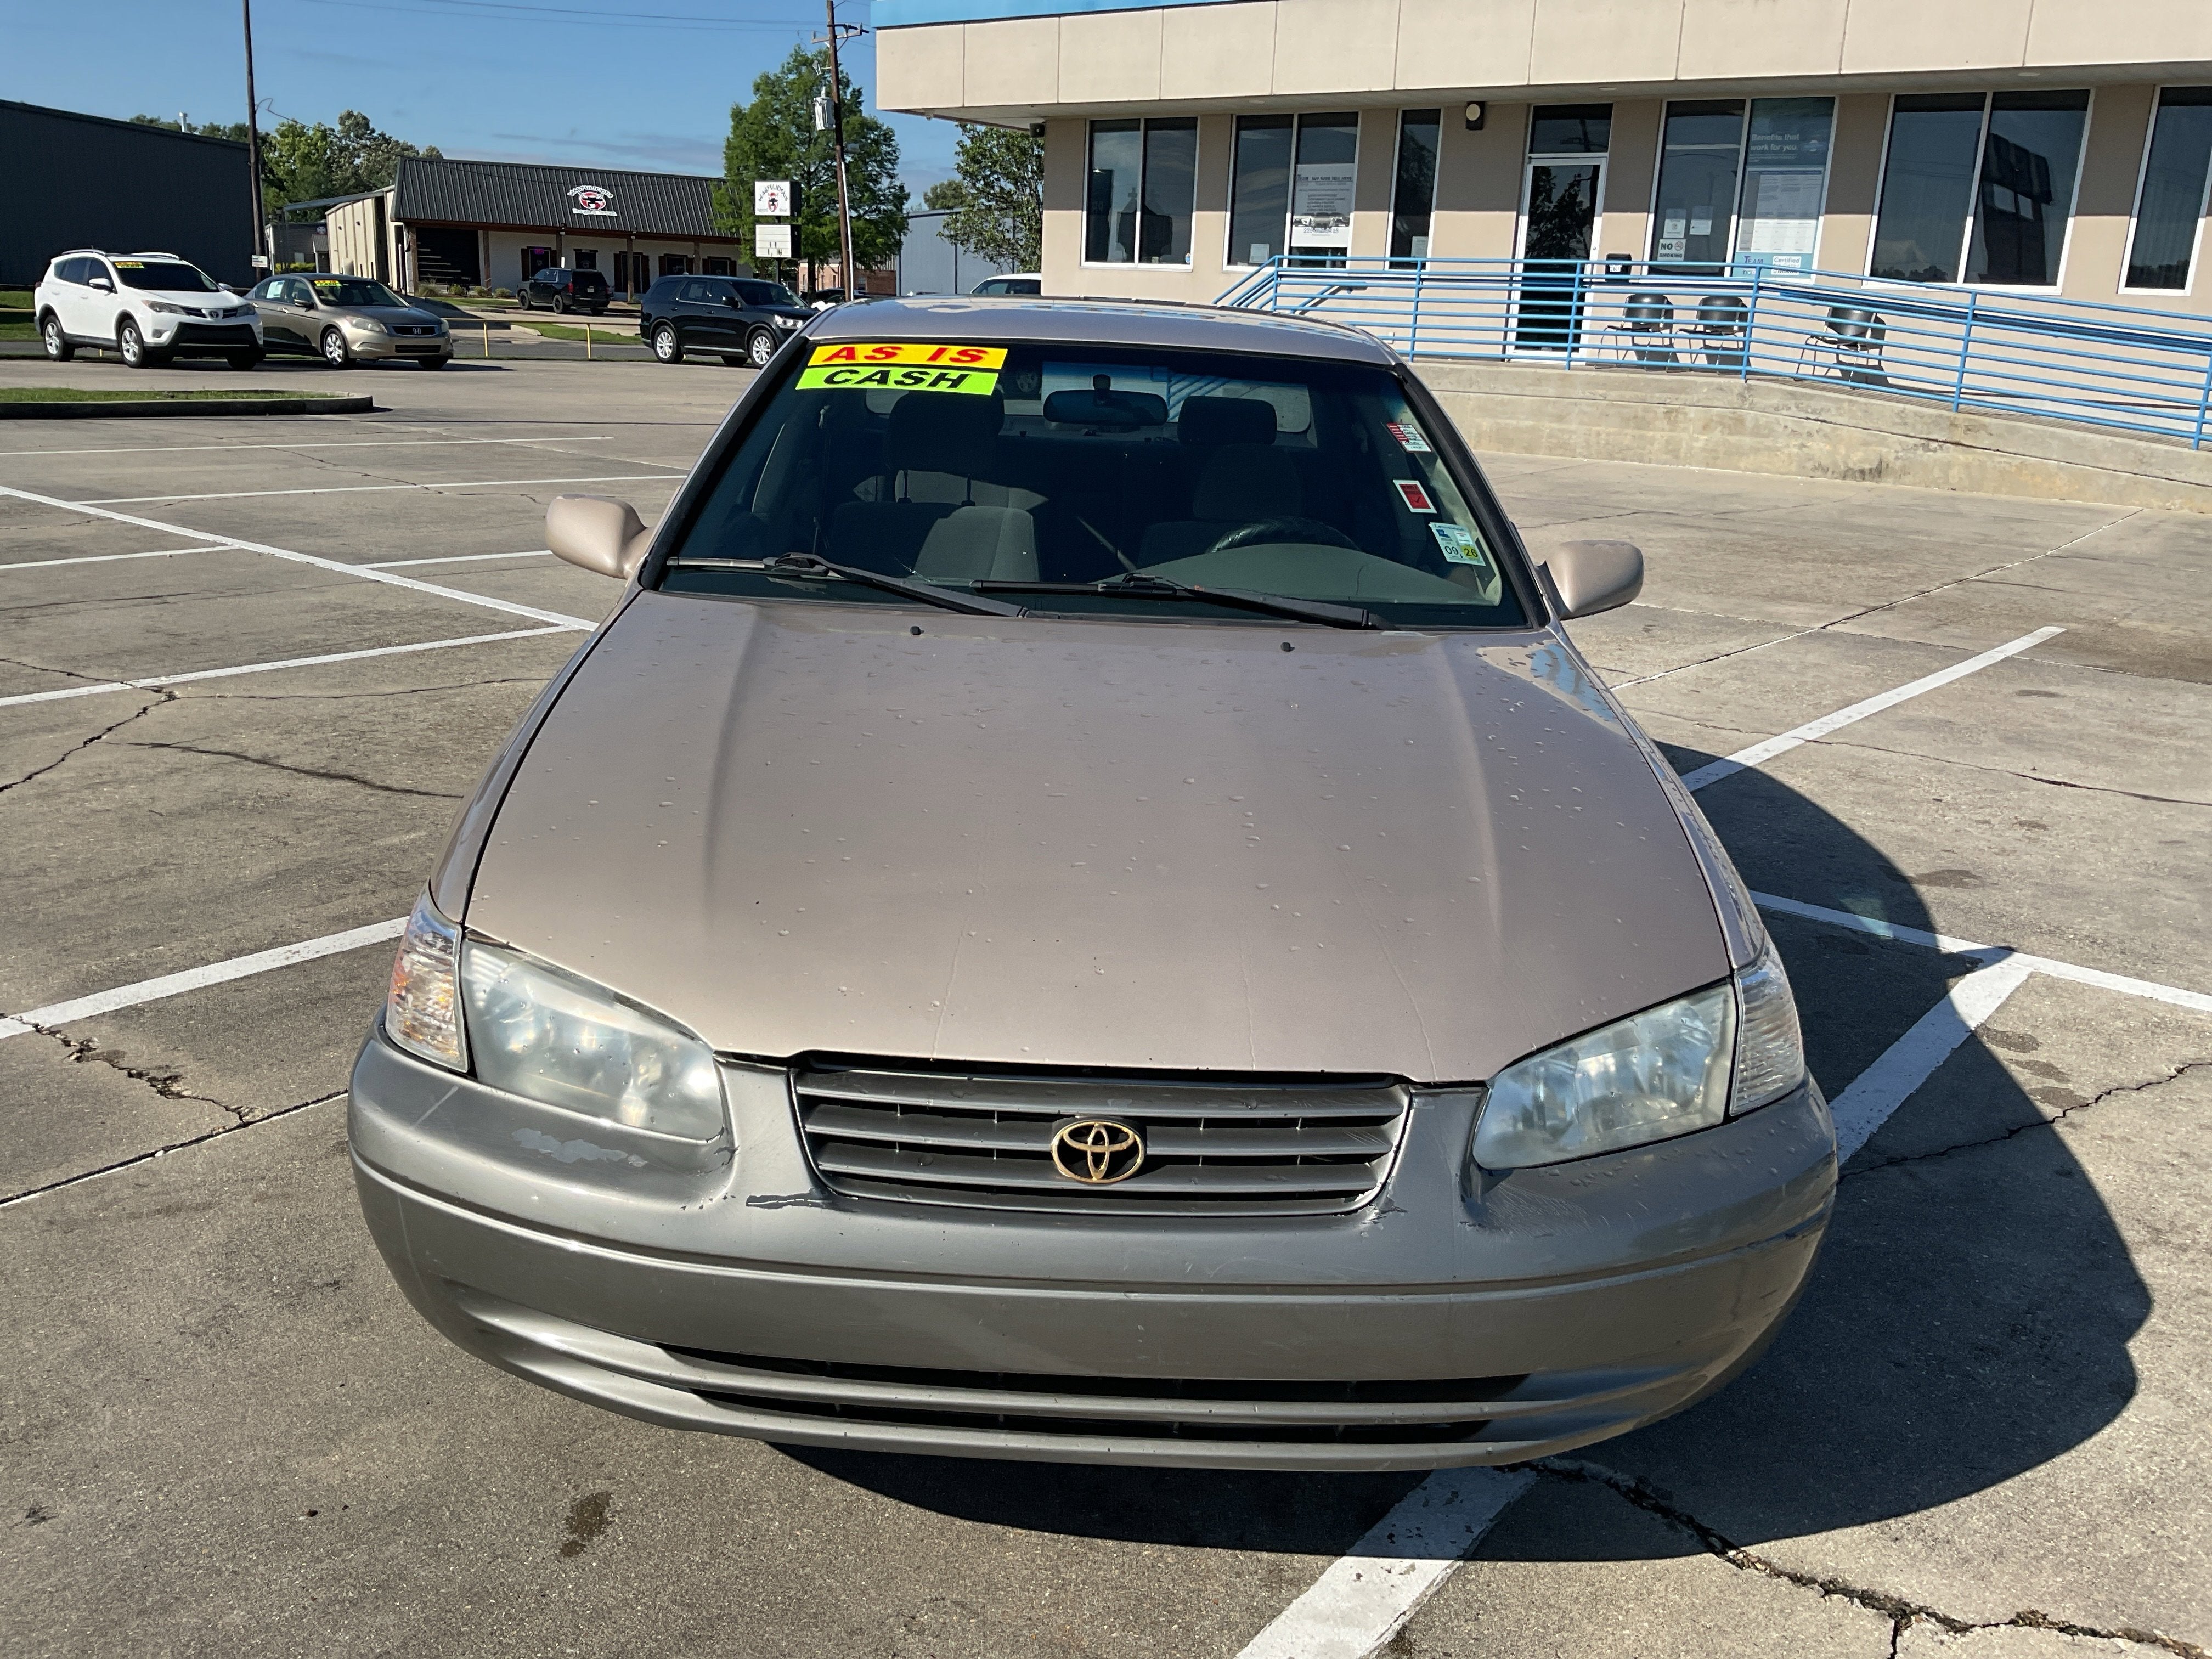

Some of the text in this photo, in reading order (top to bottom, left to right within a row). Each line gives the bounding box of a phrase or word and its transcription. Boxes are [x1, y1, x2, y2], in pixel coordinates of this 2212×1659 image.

[823, 346, 990, 363] AS IS
[823, 369, 973, 389] CASH
[1444, 546, 1478, 557] 09 26
